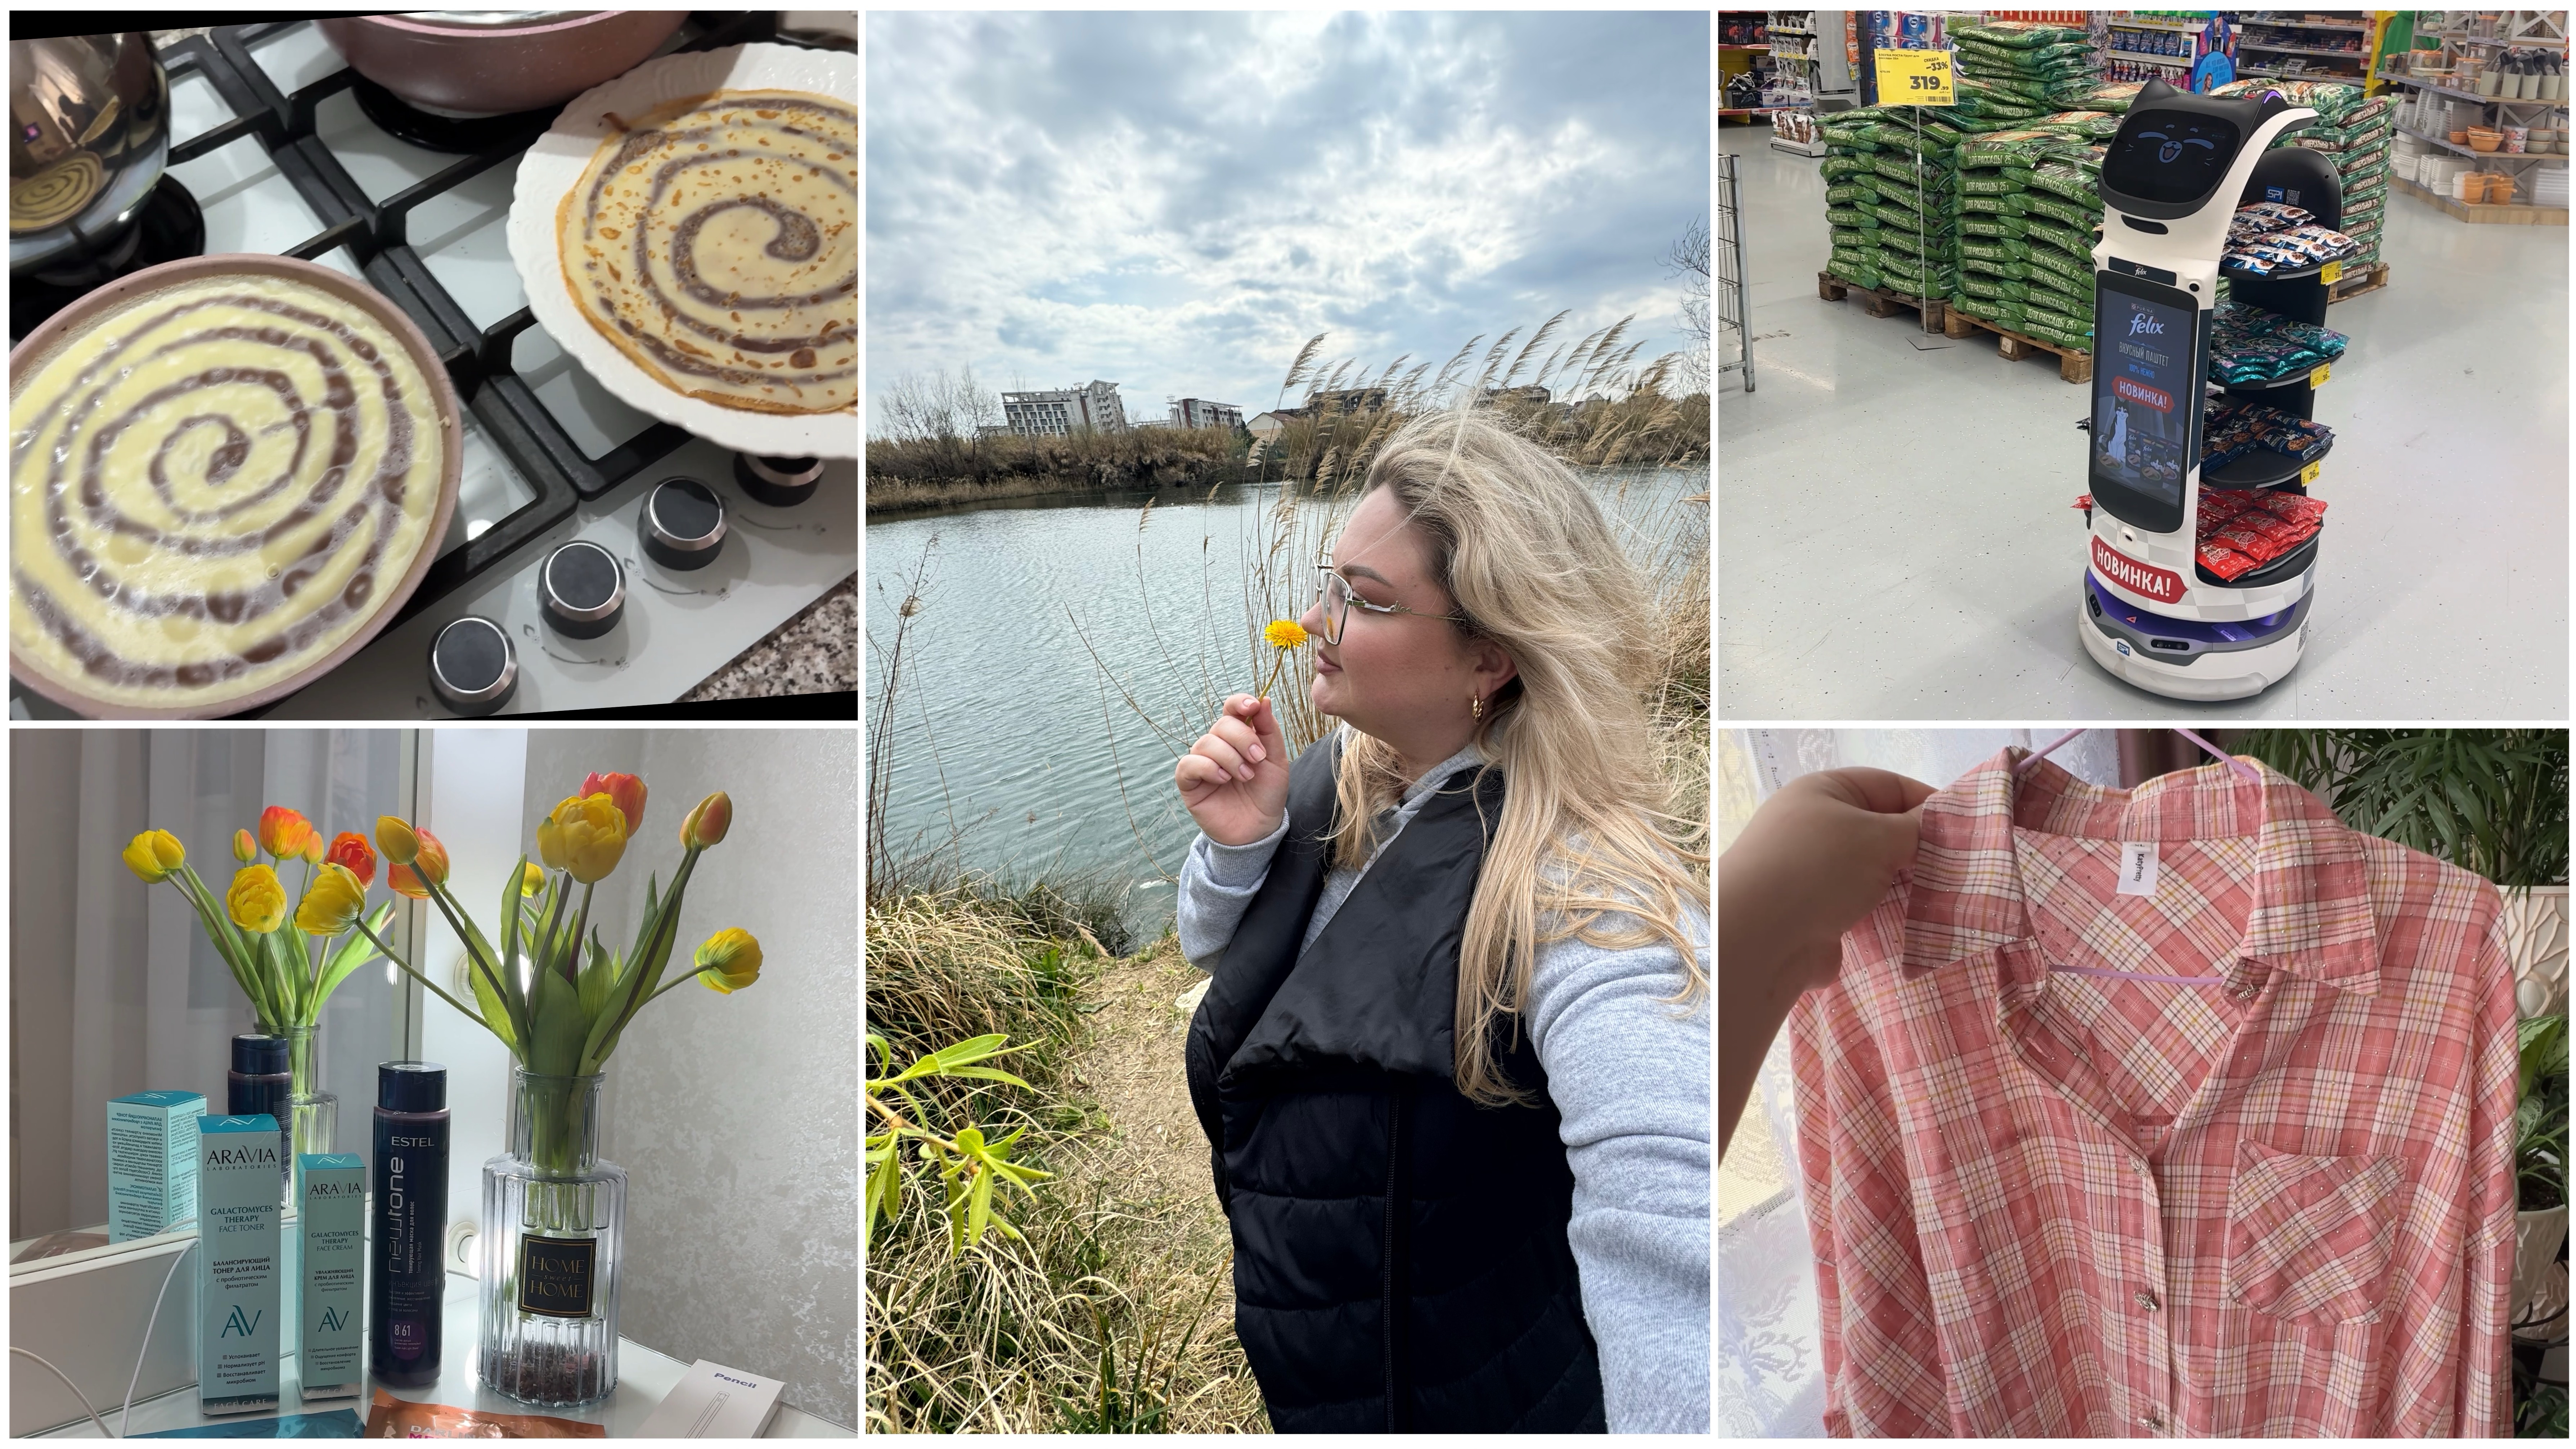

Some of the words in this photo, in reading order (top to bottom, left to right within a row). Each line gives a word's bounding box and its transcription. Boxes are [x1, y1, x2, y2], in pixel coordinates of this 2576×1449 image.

[1976, 42, 2000, 55] РАССАДЫ
[1910, 76, 1940, 90] 319
[1968, 154, 1977, 165] ДЛЯ
[1977, 155, 2002, 164] РАССАДЫ
[2005, 155, 2011, 164] 25
[2032, 175, 2046, 186] ДЛЯ
[2047, 176, 2073, 197] РАССАДЫ
[2074, 190, 2083, 202] 25
[2267, 189, 2283, 200] SPI
[1877, 184, 1887, 195] ДЛЯ
[1888, 189, 1911, 207] РАССАДЫ
[1912, 202, 1920, 211] 25
[1974, 200, 1996, 210] РАССАДЫ
[1999, 203, 2005, 212] 25
[2035, 202, 2047, 213] ДЛЯ
[2047, 205, 2074, 226] РАССАДЫ
[2076, 219, 2083, 230] 25
[2028, 225, 2041, 235] ДЛЯ
[2041, 229, 2068, 249] РАССАДЫ
[2070, 243, 2077, 253] 25
[2135, 267, 2147, 276] felix
[2032, 268, 2044, 279] ДЛЯ
[2044, 271, 2071, 292] РАССАДЫ
[2073, 288, 2080, 297] 25
[1966, 302, 1977, 312] ДЛЯ
[1977, 304, 1999, 316] РАССАДЫ
[2001, 308, 2006, 317] 25
[2136, 305, 2153, 314] PURINA
[2026, 309, 2038, 319] ДЛЯ
[2039, 312, 2065, 328] РАССАДЫ
[2066, 320, 2073, 329] 25
[2128, 313, 2164, 337] felix
[2119, 342, 2144, 358] ВКУСНЫЙ
[2146, 350, 2169, 367] ПАШТЕТ
[2129, 364, 2140, 374] 100%
[2140, 366, 2155, 379] НЕЖНО
[2120, 383, 2167, 409] НОВИНКА!
[2096, 544, 2171, 597] НОВИНКА!
[2118, 643, 2129, 654] SPI
[2134, 854, 2144, 882] KatyPretty
[391, 1136, 435, 1147] ESTEL
[207, 1145, 276, 1164] ARAVIA
[310, 1181, 361, 1195] ARAVIA
[211, 1205, 273, 1215] GALACTOMYCES
[224, 1215, 259, 1223] THERAPY
[213, 1257, 270, 1267] БАЛАНСИРУЮЩИЙ
[532, 1256, 585, 1274] HOME
[221, 1274, 267, 1283] пробиотическим
[530, 1280, 583, 1298] HOME
[223, 1369, 266, 1378] Восстанавливает
[714, 1373, 757, 1388] Pencil
[242, 1398, 267, 1407] CARE
